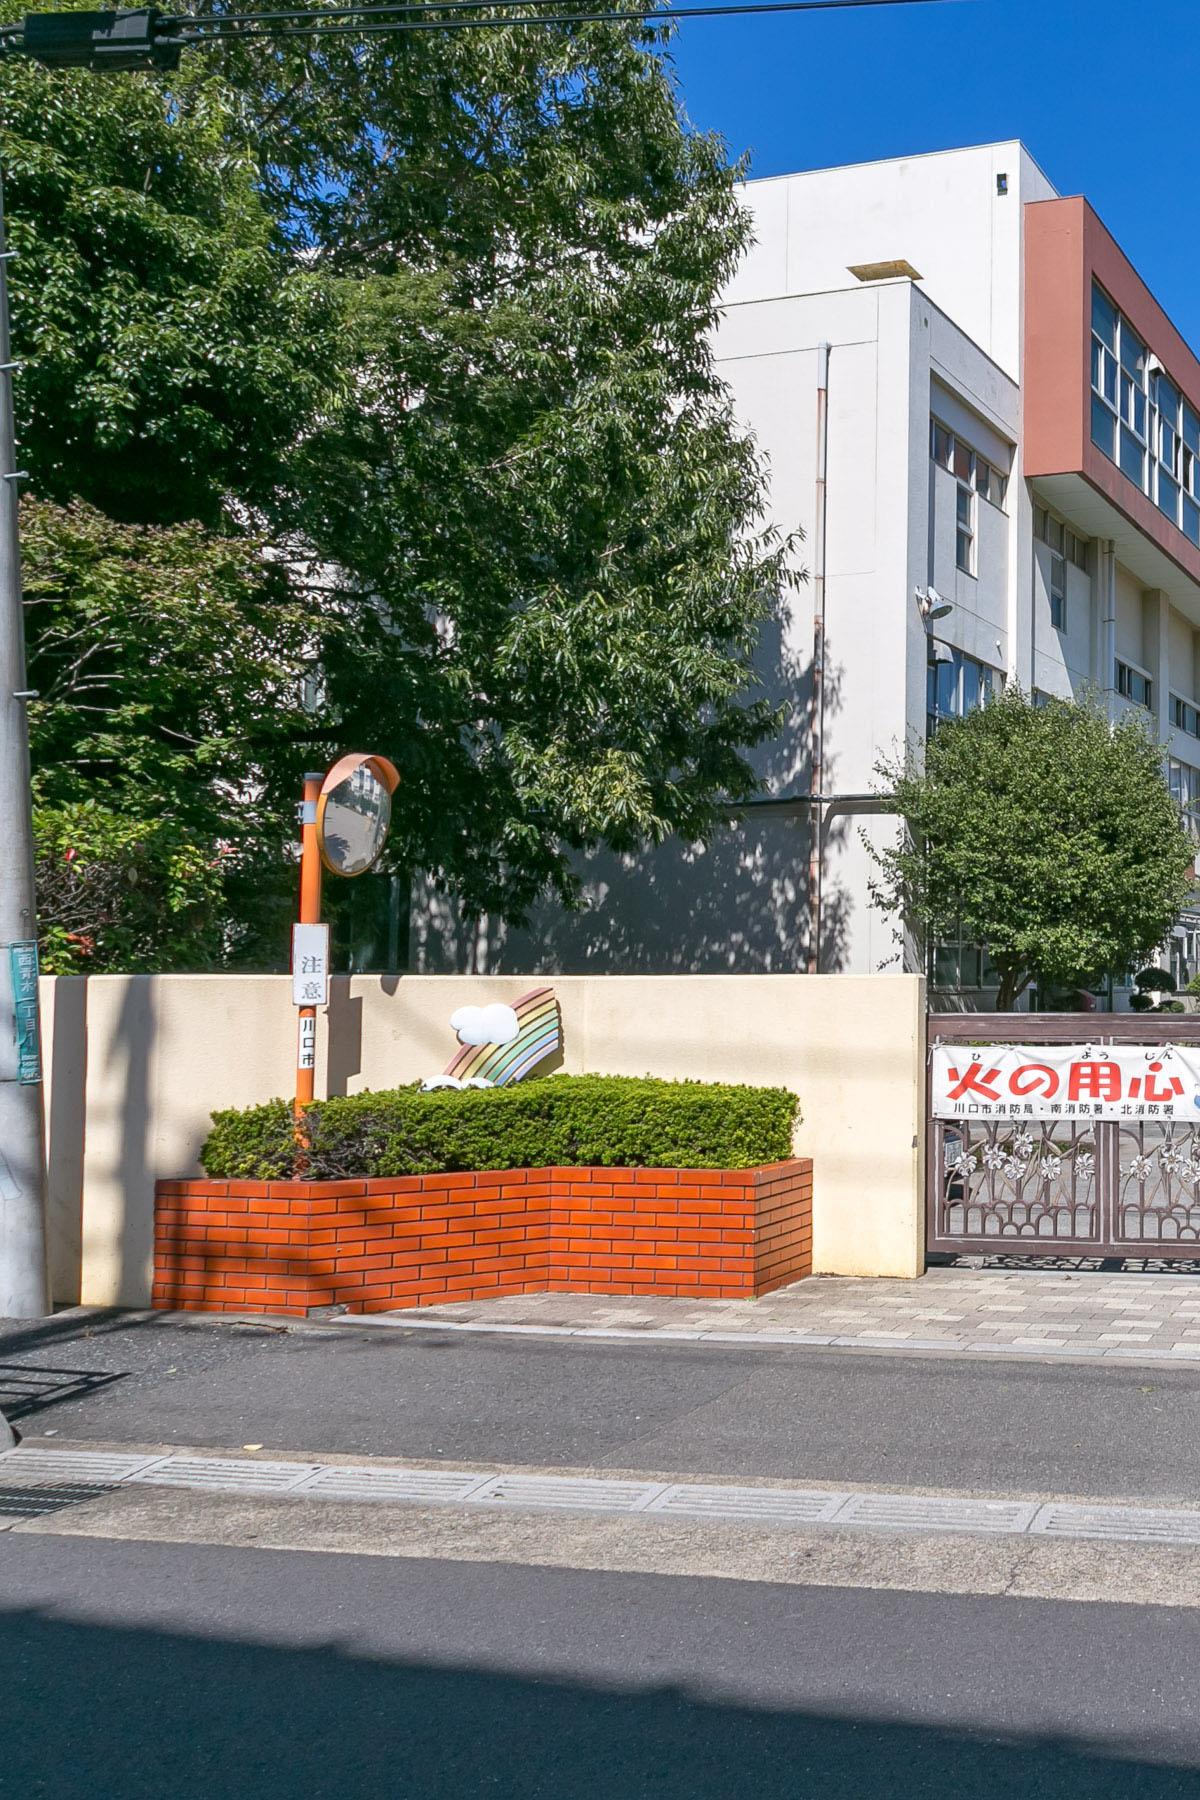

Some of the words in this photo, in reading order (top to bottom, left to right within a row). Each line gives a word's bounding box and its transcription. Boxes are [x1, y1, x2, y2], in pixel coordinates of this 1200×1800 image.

[301, 955, 322, 999] 注意
[302, 1019, 315, 1066] 川口市
[972, 1052, 981, 1061] ひ
[1145, 1052, 1173, 1061] じん
[946, 1062, 1184, 1101] 火の用心
[953, 1103, 1175, 1115] 川口市消防局・南消防署・北消防署
